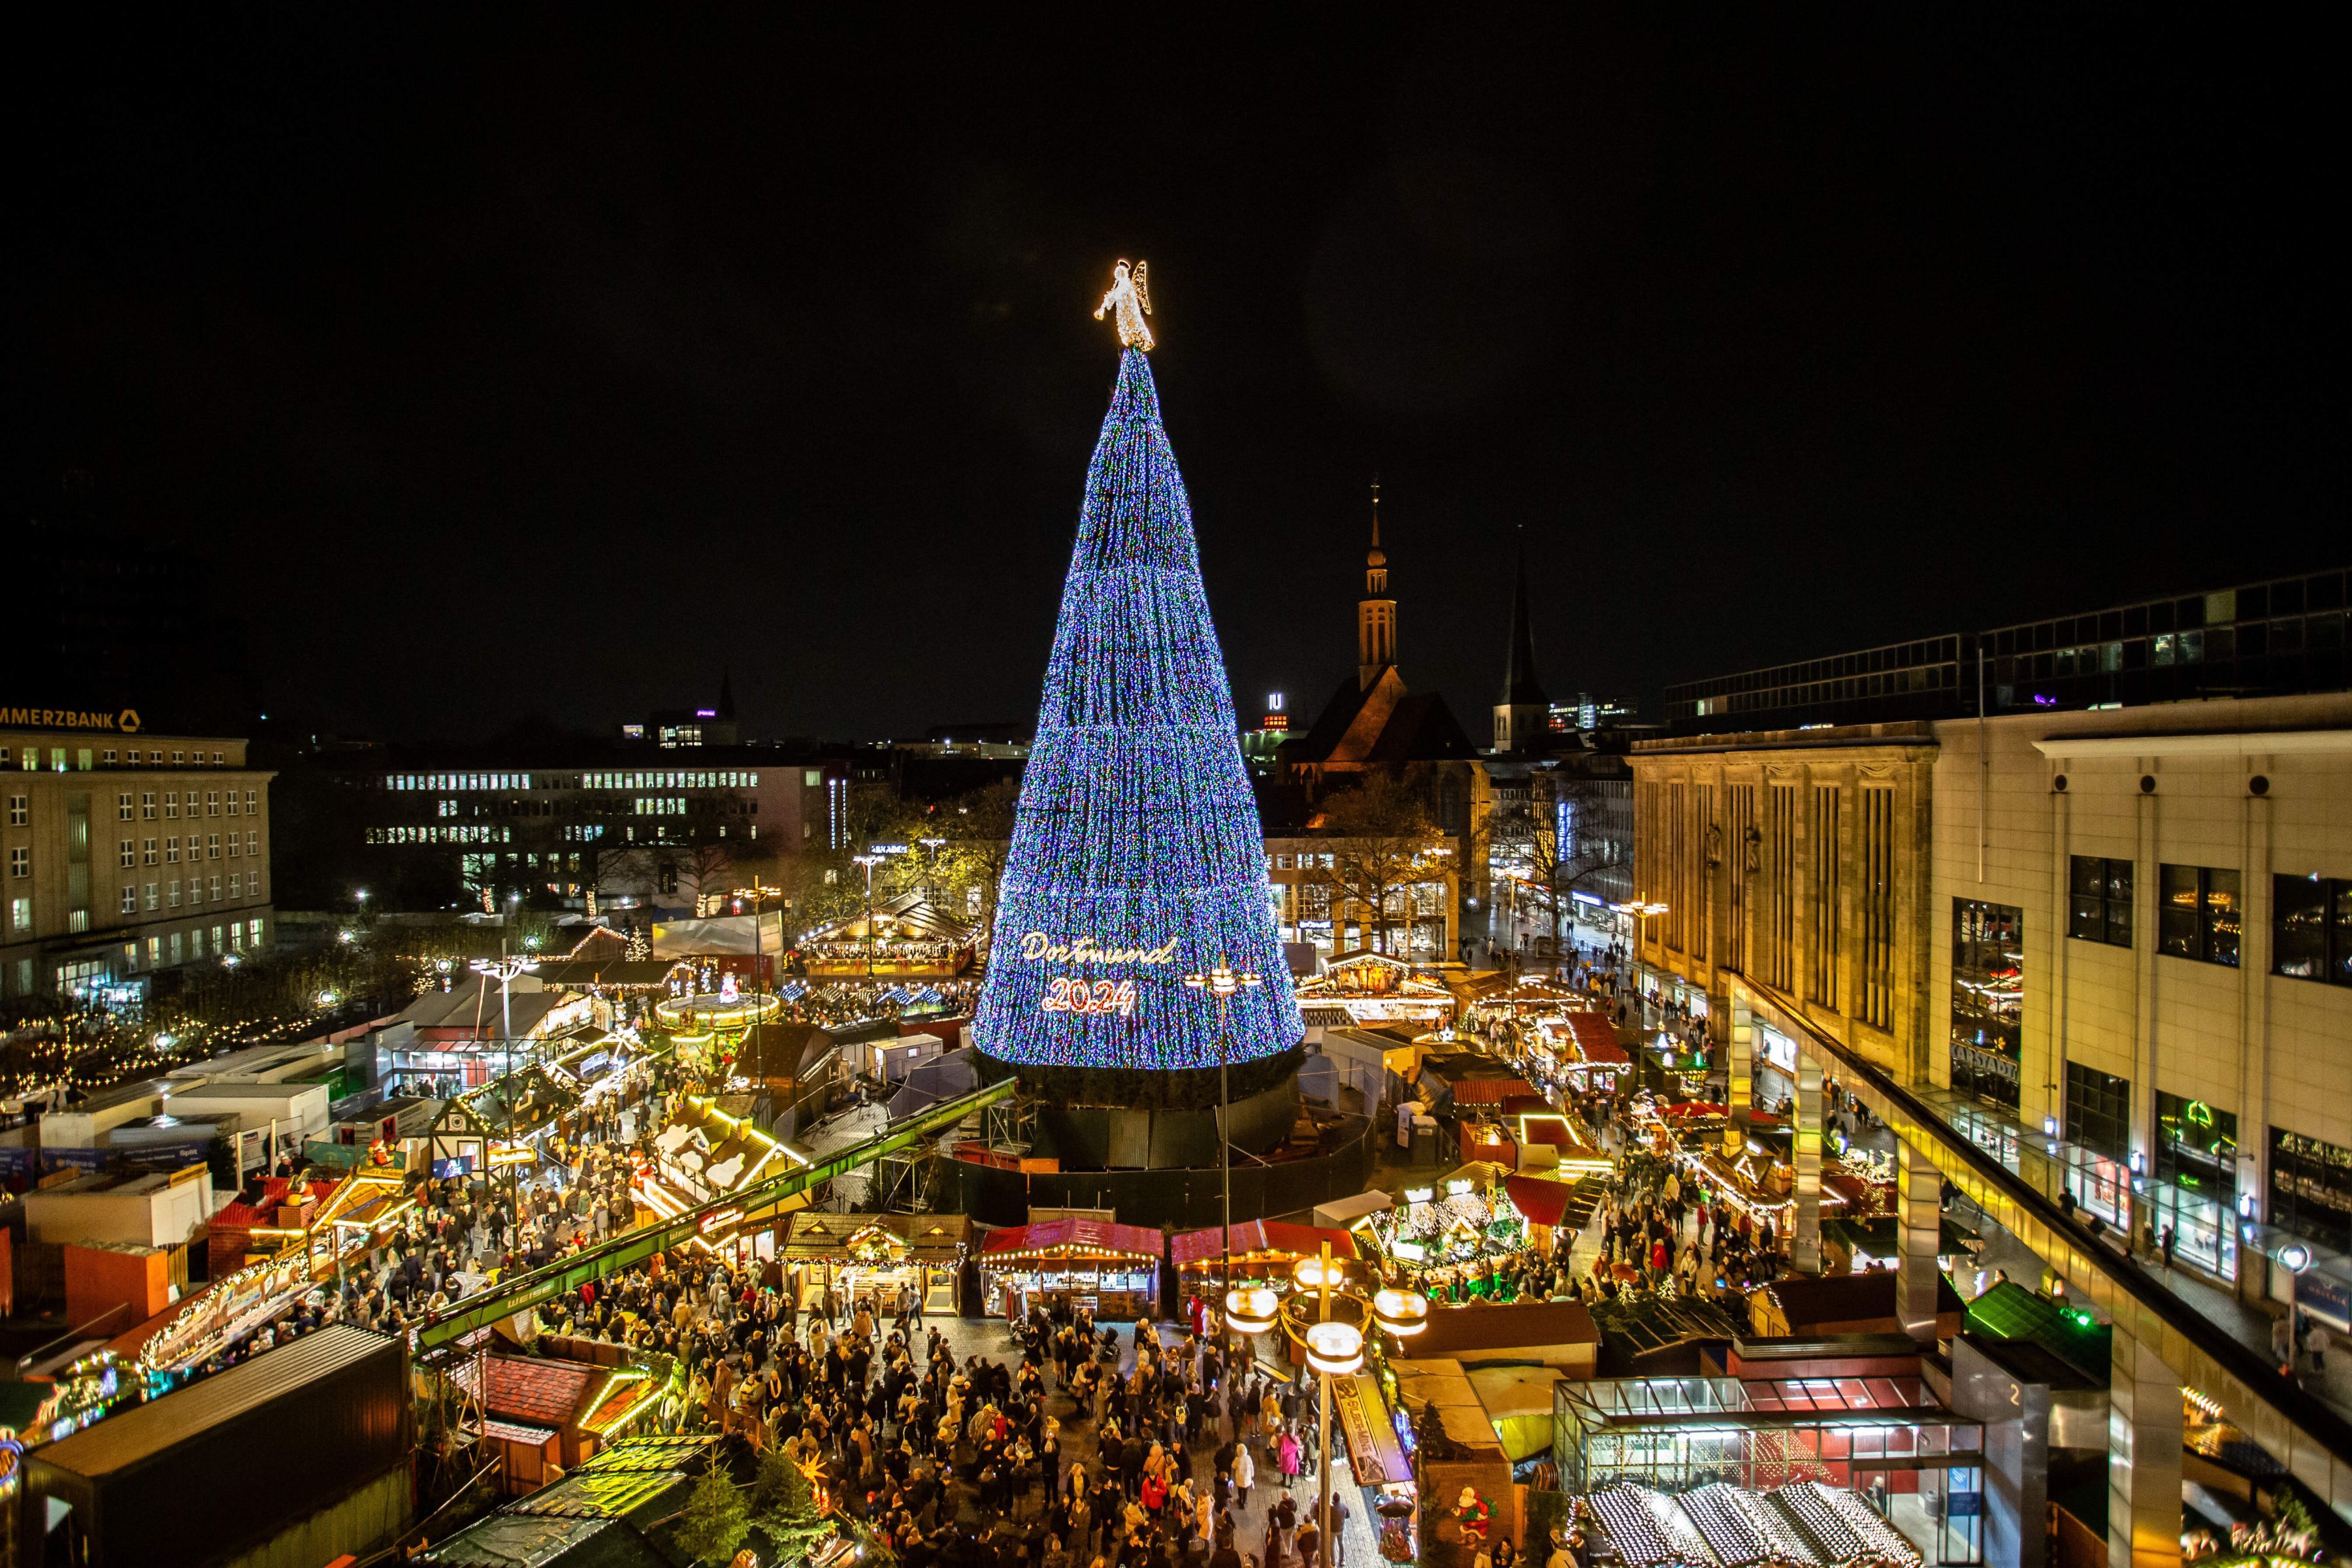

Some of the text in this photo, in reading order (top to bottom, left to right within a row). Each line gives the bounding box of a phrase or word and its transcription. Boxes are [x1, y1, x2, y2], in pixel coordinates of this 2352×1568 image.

[1022, 930, 1177, 966] Dortmund
[1041, 977, 1136, 1015] 2024
[1950, 1044, 2016, 1081] KARSTADT
[180, 1149, 198, 1157] Split
[857, 1147, 880, 1161] WEISE
[748, 1191, 777, 1208] WEISE
[507, 1284, 551, 1309] WEISE
[2010, 1383, 2019, 1406] 2
